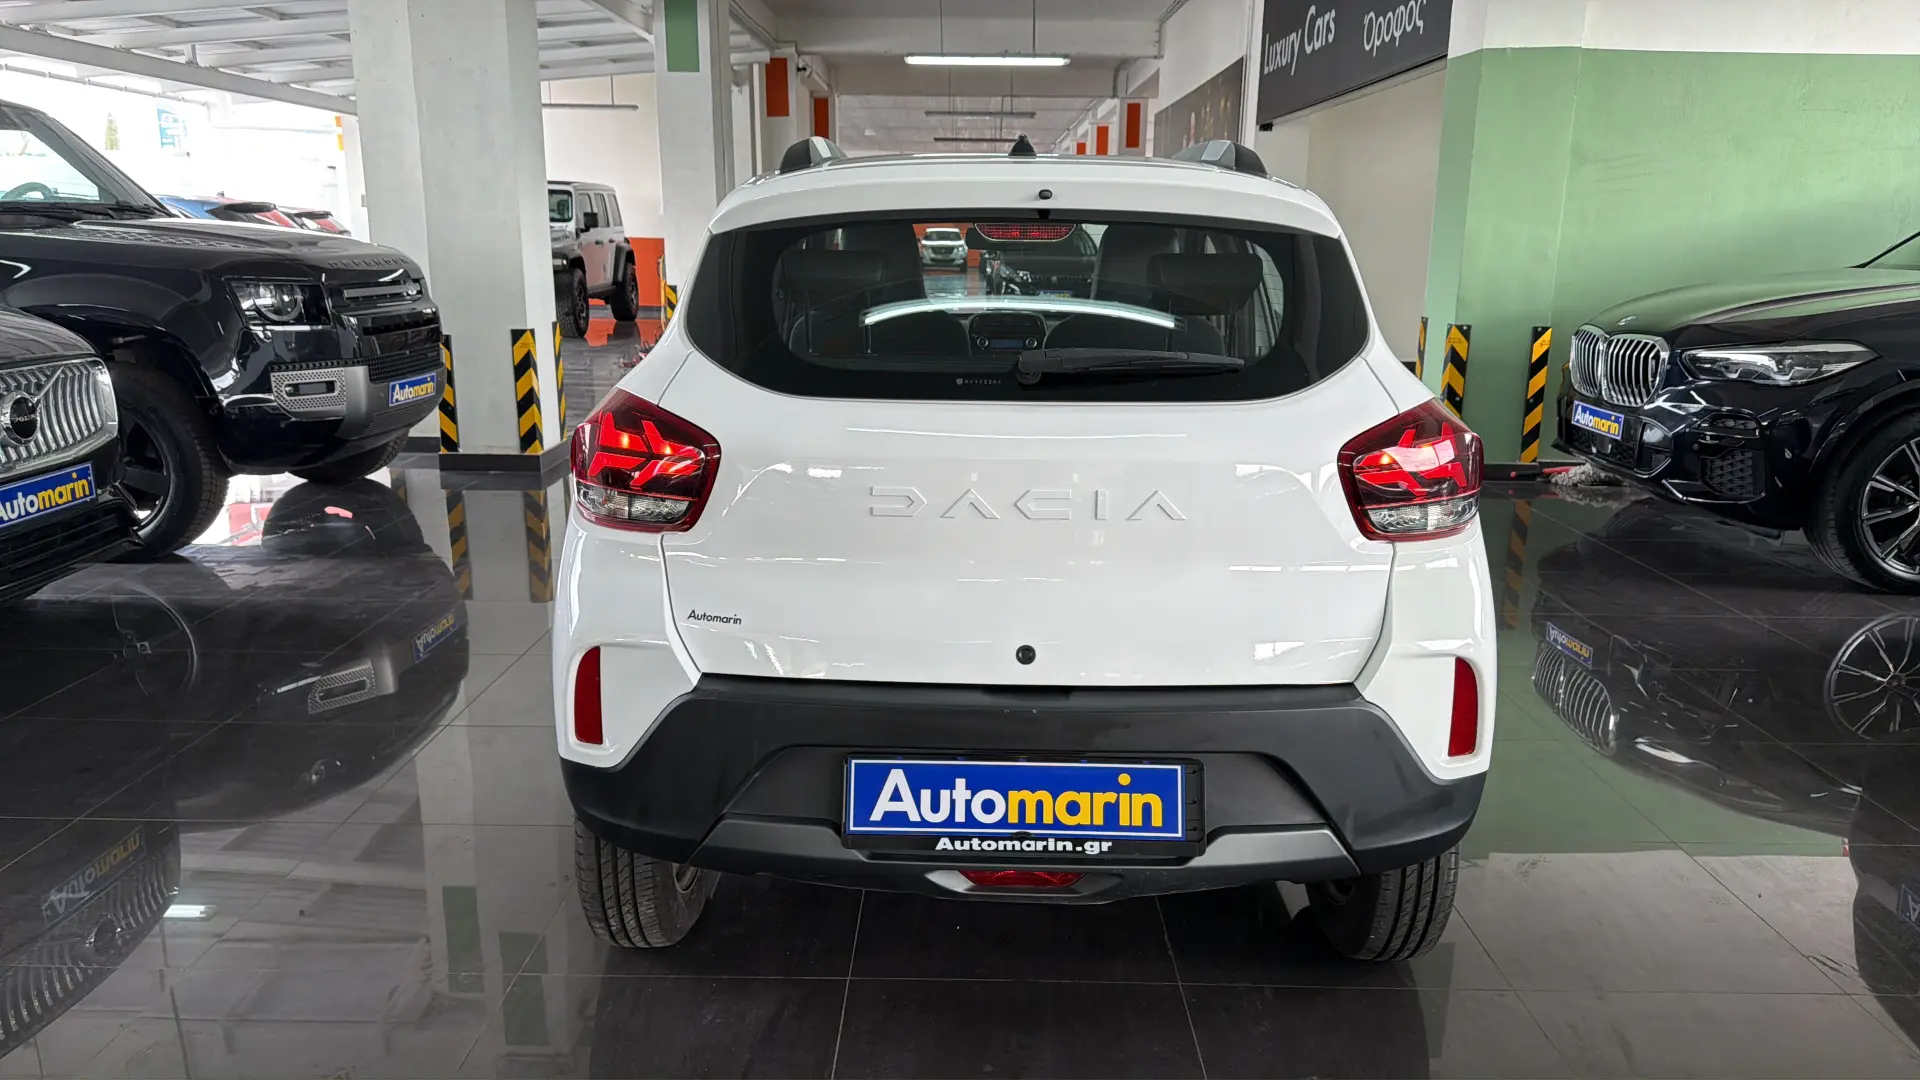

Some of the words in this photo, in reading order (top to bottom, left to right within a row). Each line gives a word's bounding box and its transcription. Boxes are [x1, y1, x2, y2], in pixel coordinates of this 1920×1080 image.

[1263, 29, 1302, 76] Luxury
[1304, 4, 1336, 55] Cars
[393, 376, 434, 403] Automarin
[1574, 405, 1619, 436] Automarin
[870, 486, 1188, 521] DACIA
[687, 609, 742, 625] Automarin
[869, 768, 1163, 828] Automarin
[935, 836, 1113, 855] Automarin.gr
